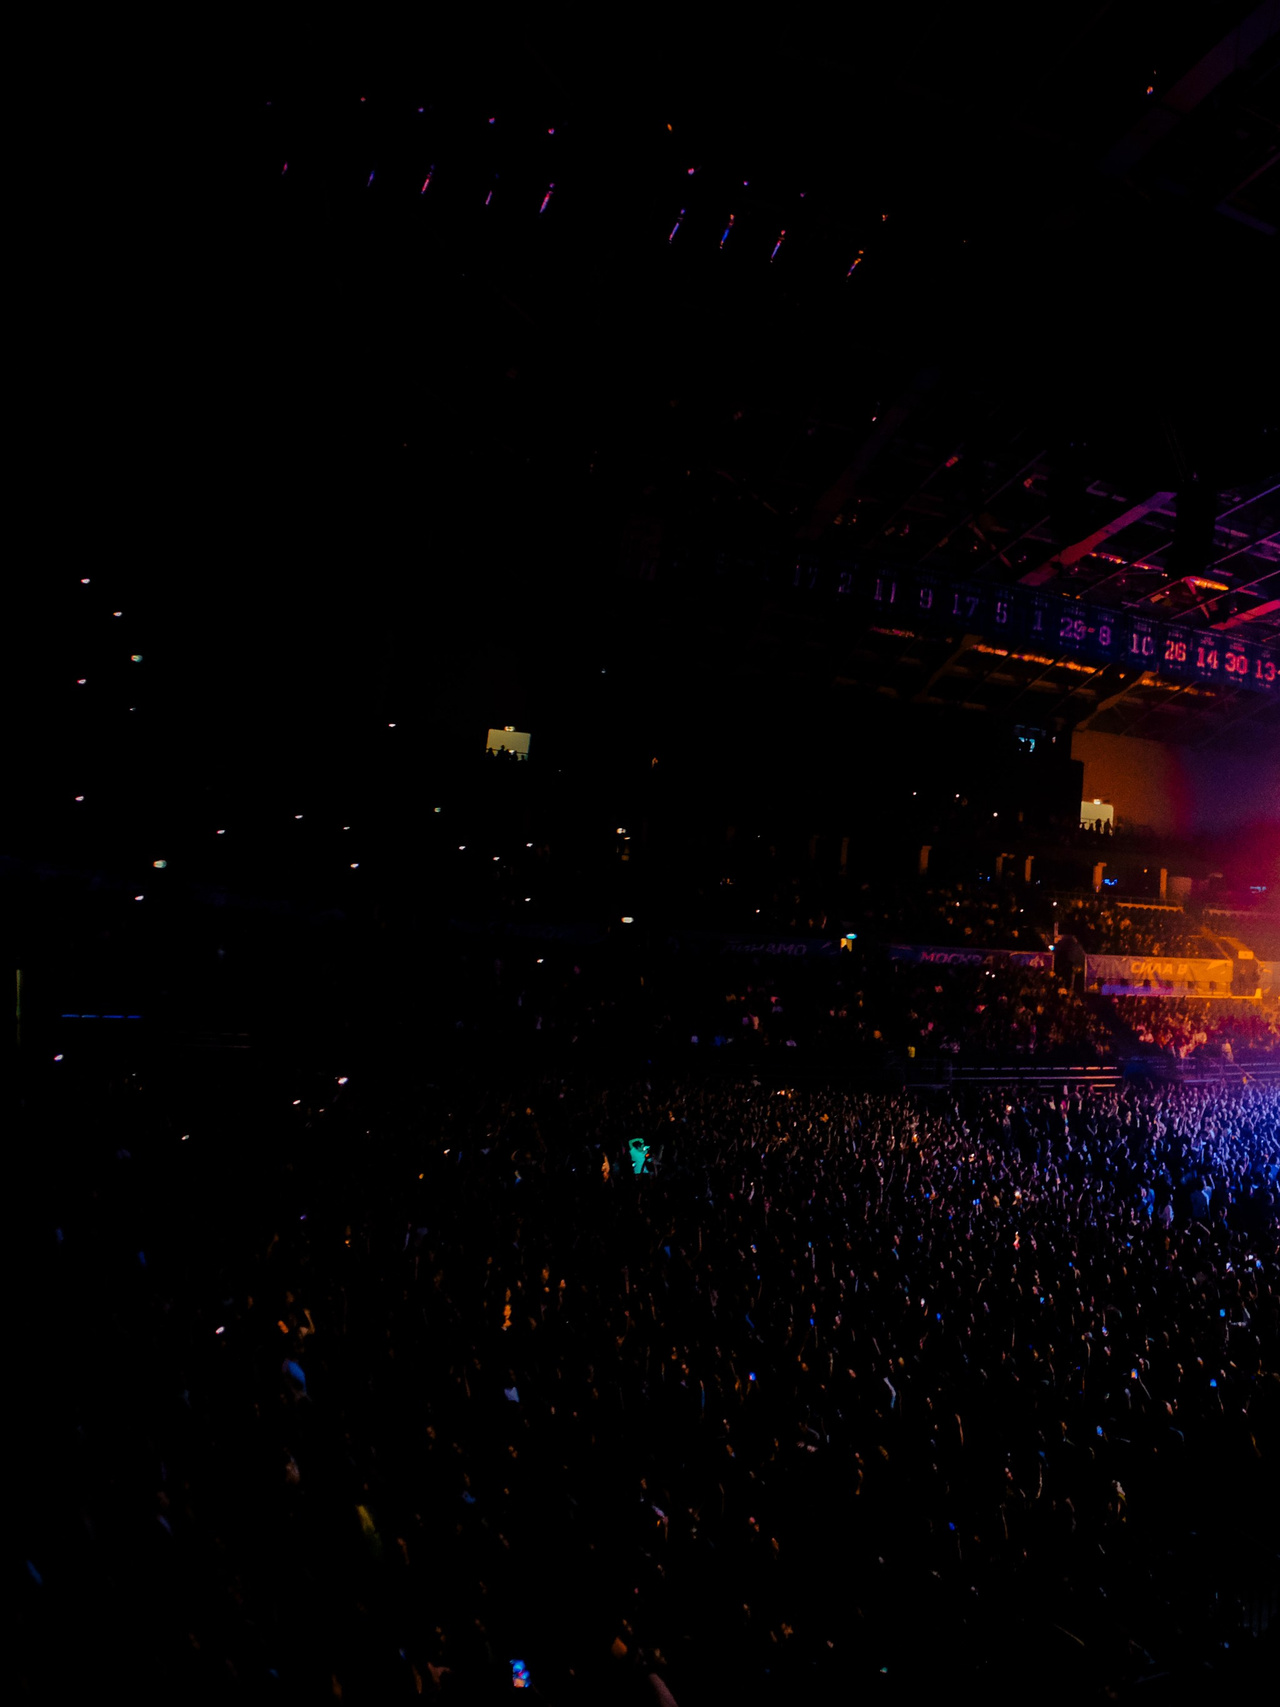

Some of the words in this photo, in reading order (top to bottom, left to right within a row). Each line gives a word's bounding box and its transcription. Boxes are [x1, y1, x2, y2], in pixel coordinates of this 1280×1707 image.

[952, 592, 980, 618] 17
[1196, 646, 1219, 670] 14
[1224, 651, 1249, 676] 30
[1131, 961, 1173, 975] СИЛА
[1176, 963, 1189, 975] В
